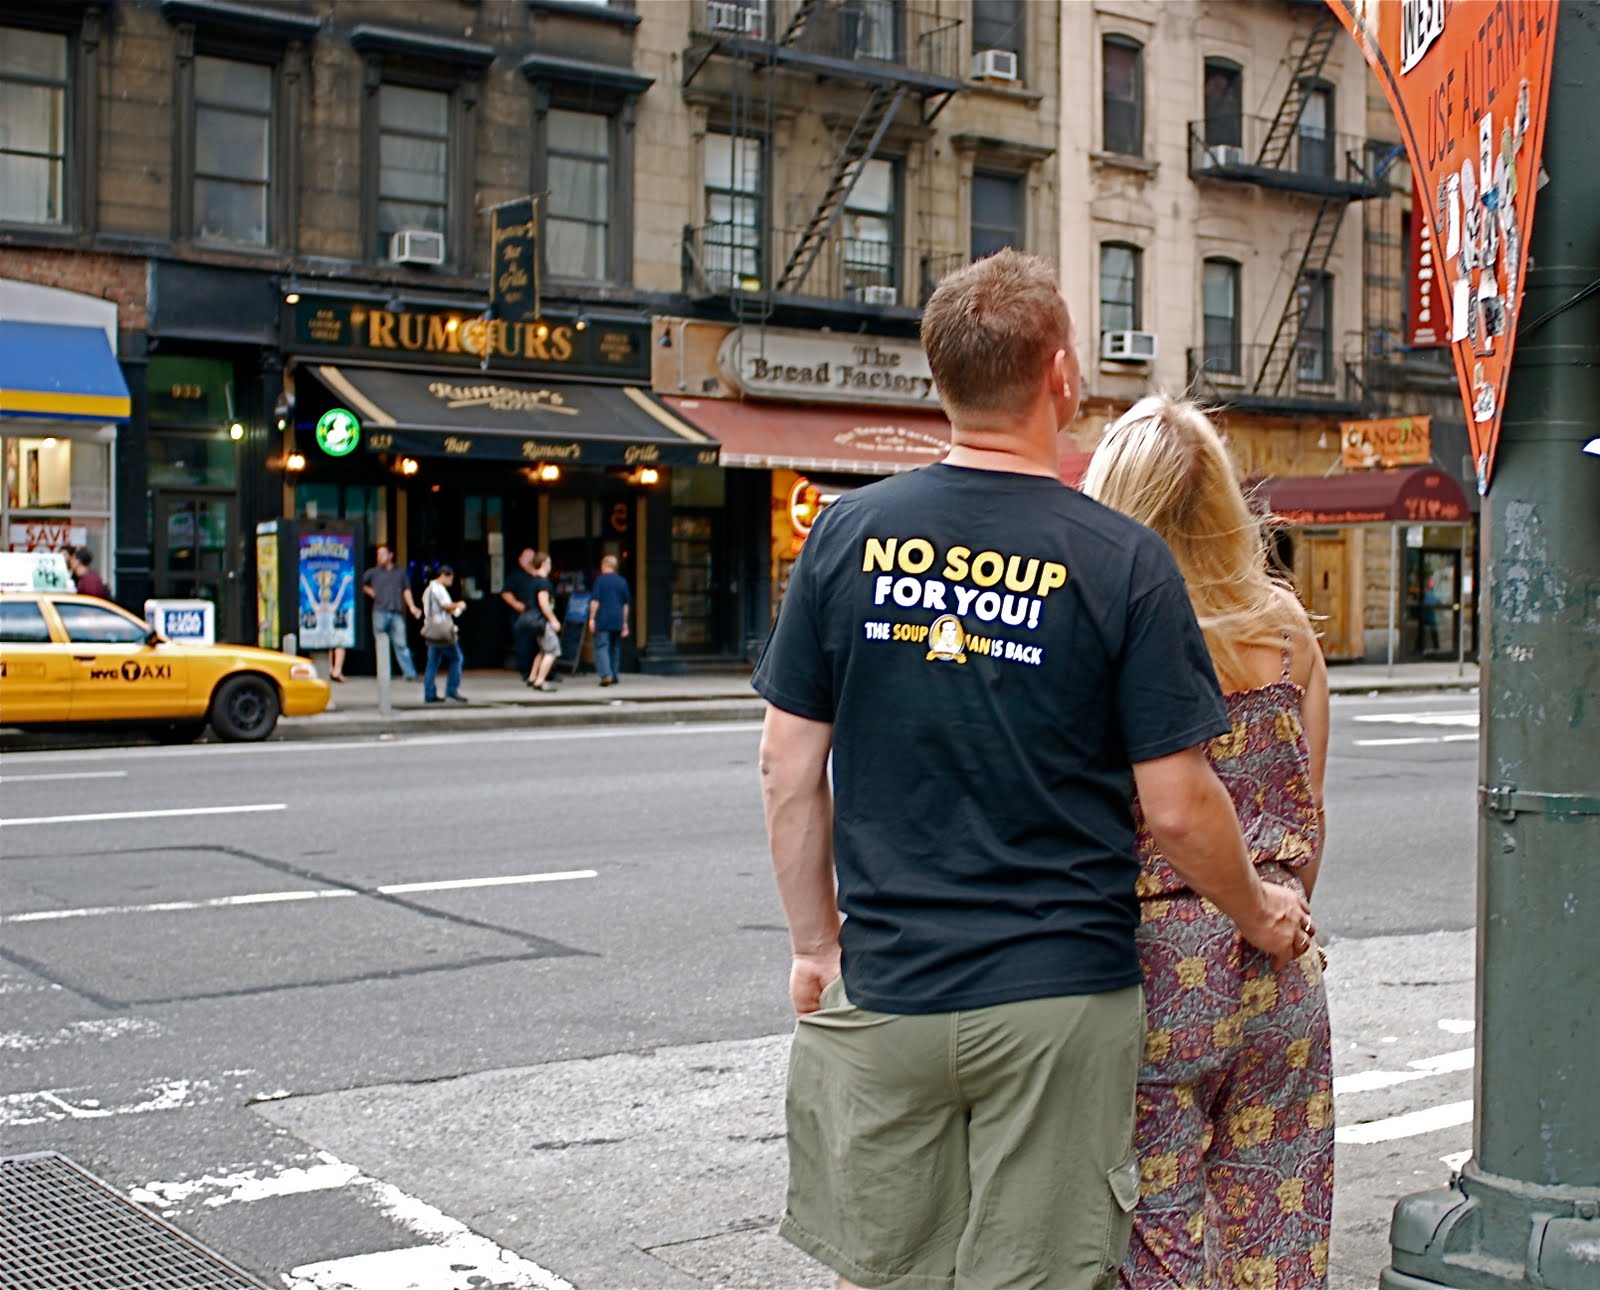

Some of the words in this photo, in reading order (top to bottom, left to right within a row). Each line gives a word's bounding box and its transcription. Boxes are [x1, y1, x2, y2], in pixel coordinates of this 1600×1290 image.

[1428, 68, 1455, 172] USE
[368, 309, 573, 361] RUMOURS
[853, 344, 902, 367] The
[747, 357, 830, 384] Bread
[836, 363, 933, 398] Factory
[444, 436, 472, 454] Bar
[521, 440, 582, 460] Rumour's
[624, 444, 660, 465] Grille
[26, 525, 71, 546] SAVE
[862, 537, 935, 574] NO
[942, 546, 1067, 597] SOUP
[874, 575, 947, 611] FOR
[953, 585, 1042, 629] YOU!
[864, 621, 890, 640] THE
[892, 623, 929, 643] SOUP
[990, 638, 1003, 657] IS
[1005, 641, 1043, 666] BACK
[90, 670, 118, 680] NYC
[121, 660, 172, 682] TAXI
